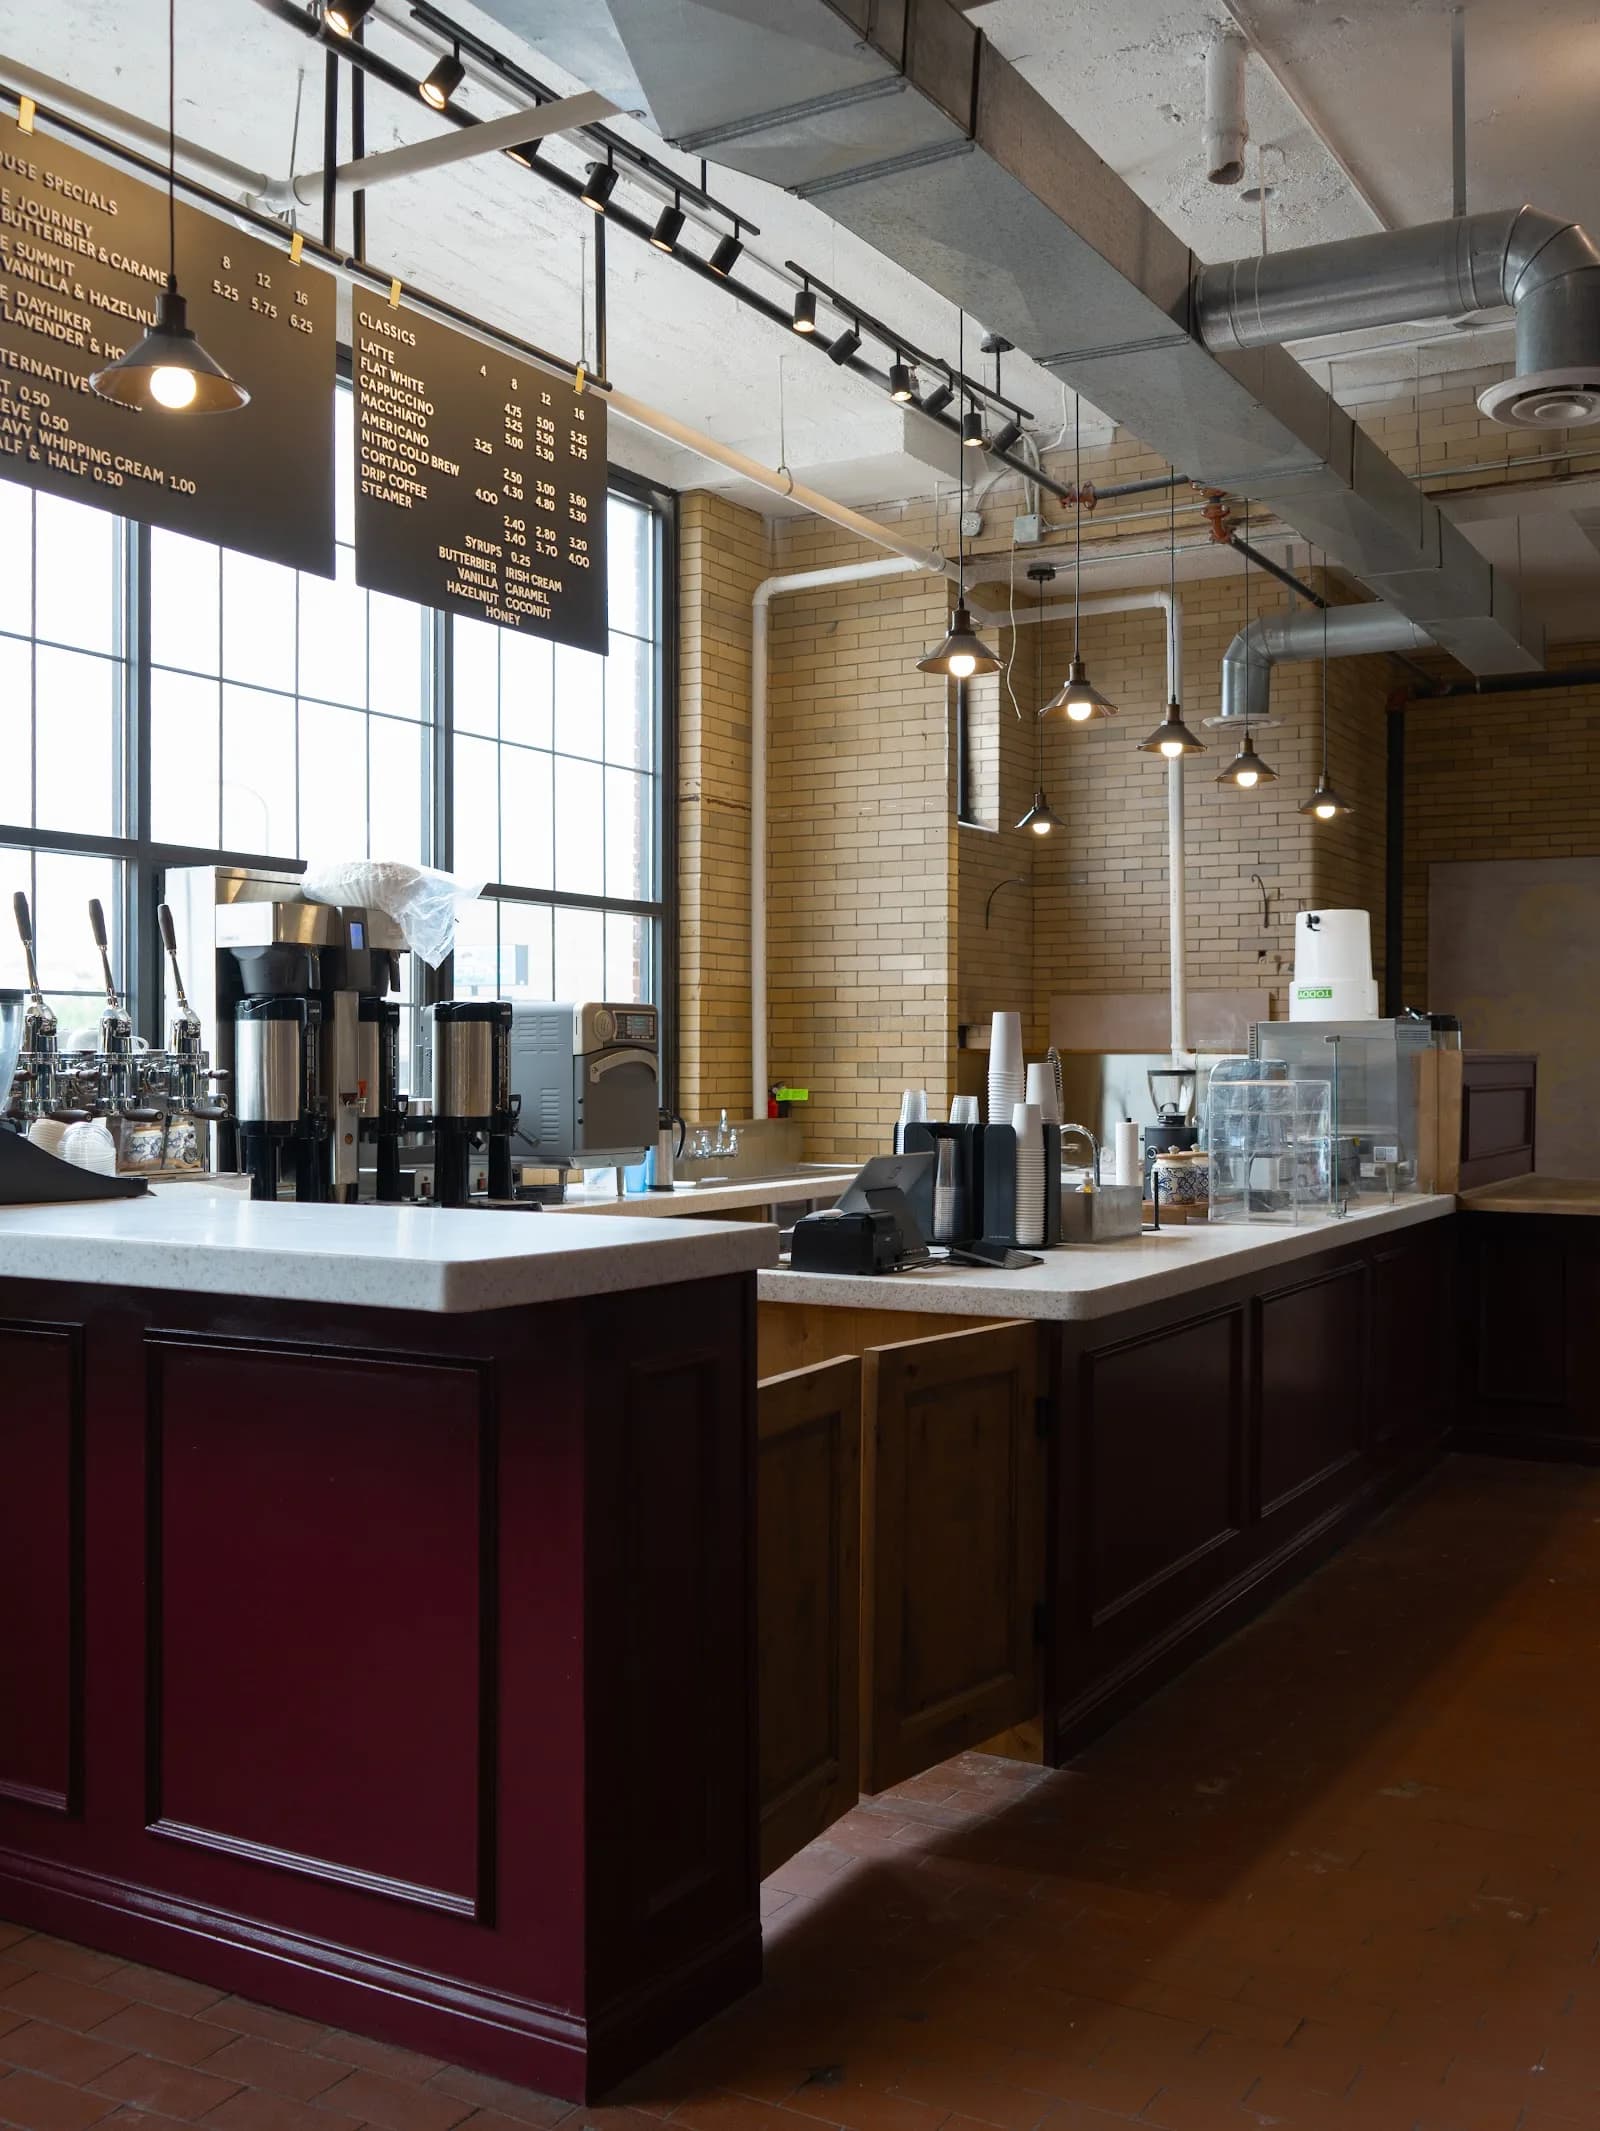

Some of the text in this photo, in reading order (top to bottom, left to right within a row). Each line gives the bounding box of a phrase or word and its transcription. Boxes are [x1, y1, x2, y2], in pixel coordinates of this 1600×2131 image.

[0, 150, 37, 180] USE
[47, 172, 117, 215] SPECIALS
[18, 197, 92, 238] JOURNEY
[2, 206, 96, 257] BUTTERBIER
[99, 247, 108, 263] &
[111, 253, 168, 287] CARAME
[17, 242, 75, 276] SUMMIT
[3, 255, 69, 294] VANILLA
[75, 283, 84, 299] &
[90, 289, 157, 327] HAZELNU
[223, 256, 308, 305] 8 12 16
[5, 304, 84, 347] LAVENDER
[90, 338, 100, 353] &
[18, 291, 91, 333] DAYHIKER
[214, 280, 312, 333] 5.25 5.75 6.25
[360, 312, 416, 346] CLASSICS
[0, 348, 90, 393] TERNATIVE
[361, 338, 587, 446] LATTE 4.75 5.00 5.25
[480, 365, 584, 420] 4 8 12 16
[1, 398, 69, 431] EVE 0.50
[20, 386, 50, 407] 0.50
[360, 375, 554, 462] CAPPUCCINO 5.00 5.30
[361, 358, 587, 460] FLAT WHITE 5.25 5.50 5.75
[361, 392, 492, 454] MACCHIATO 3.25
[0, 418, 196, 494] AVY WHIPPING CREAM 1.00
[30, 444, 40, 460] &
[48, 452, 88, 475] HALF
[94, 467, 123, 486] 0.50
[362, 411, 587, 508] AMERICANO 2.50 3.00 3.60
[362, 428, 587, 523] NITRO COLD BREW 4.30 4.80 5.30
[362, 446, 498, 505] CORTADO 4.00
[362, 464, 587, 551] DRIP COFFEE 2.40 2.80 3.20
[362, 481, 589, 568] STEAMER 3.40 3.70 4.00
[439, 546, 562, 592] BUTTERBIER IRISH CREAM
[465, 536, 530, 567] SYRUPS 0.25
[447, 580, 551, 619] HAZELNUT COCONUT
[457, 567, 549, 604] VANILLA CARAMEL
[486, 605, 520, 625] HONEY
